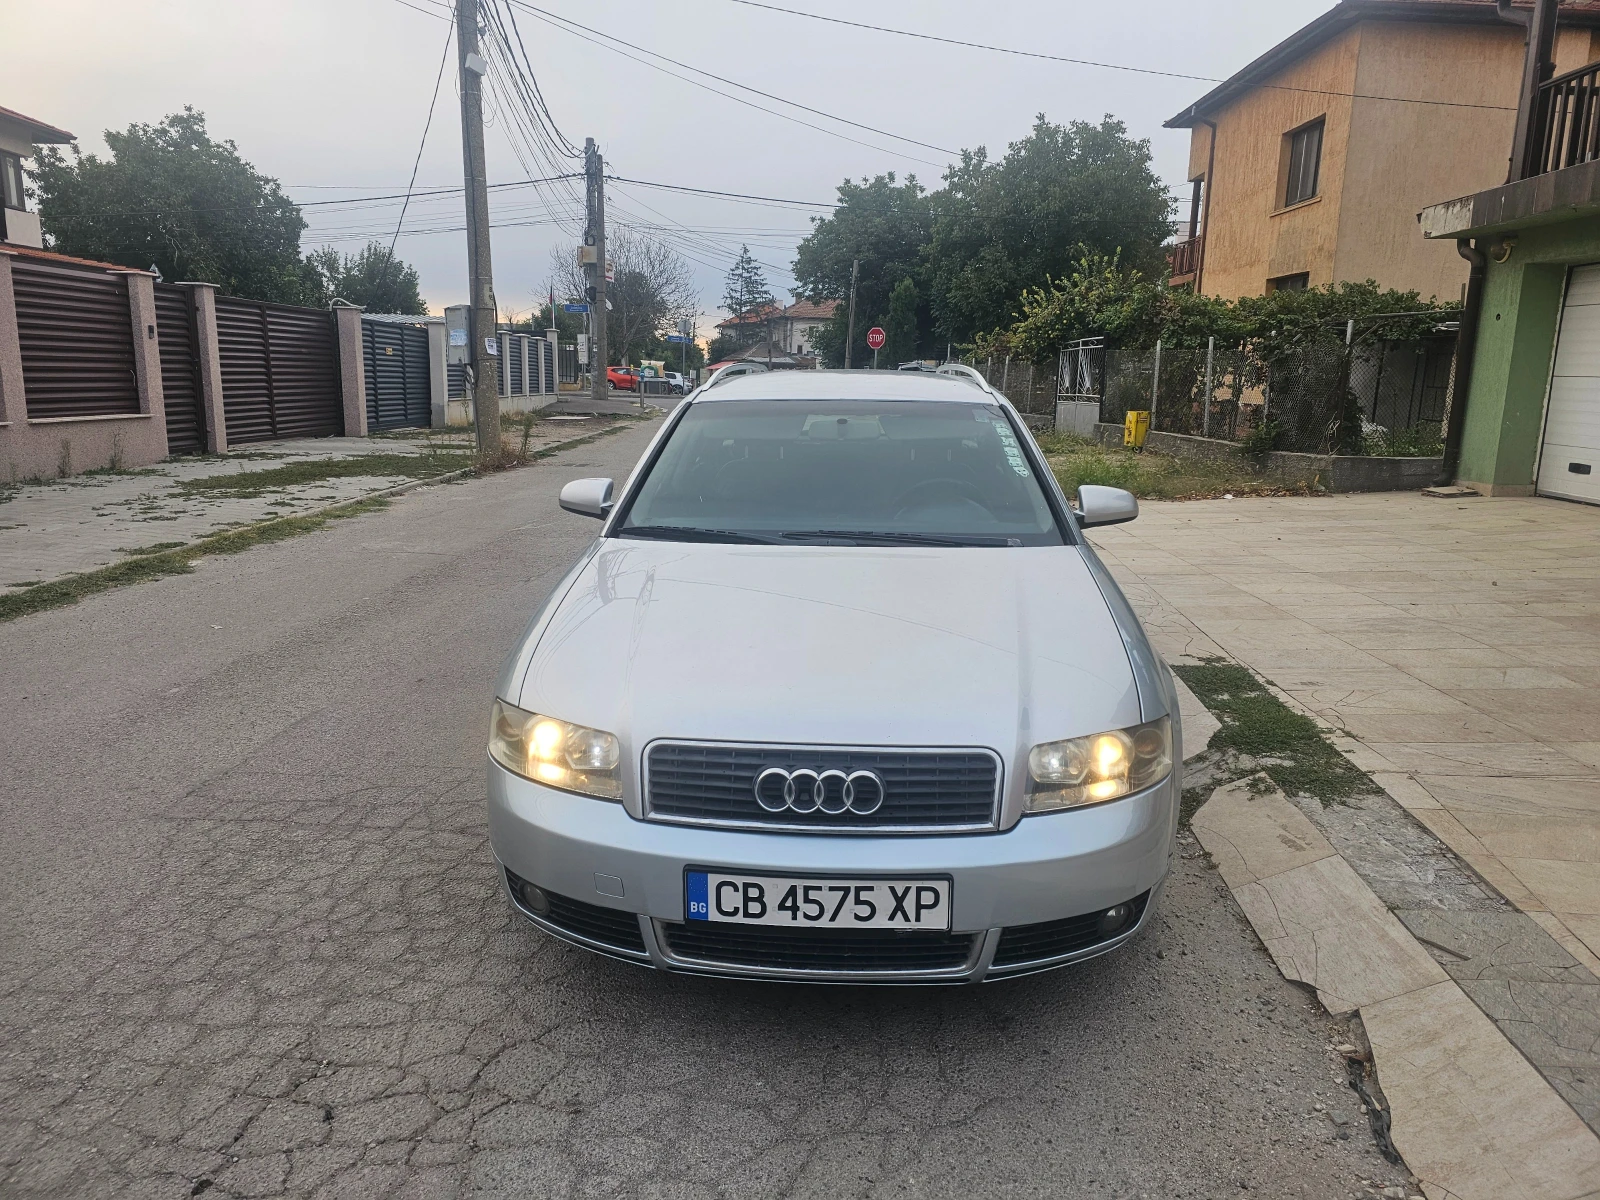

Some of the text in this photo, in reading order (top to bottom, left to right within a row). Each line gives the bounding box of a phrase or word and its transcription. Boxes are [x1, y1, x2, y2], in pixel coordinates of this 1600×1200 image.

[869, 334, 884, 342] STOP
[690, 901, 707, 914] BG
[715, 880, 941, 923] CB 4575 XP
